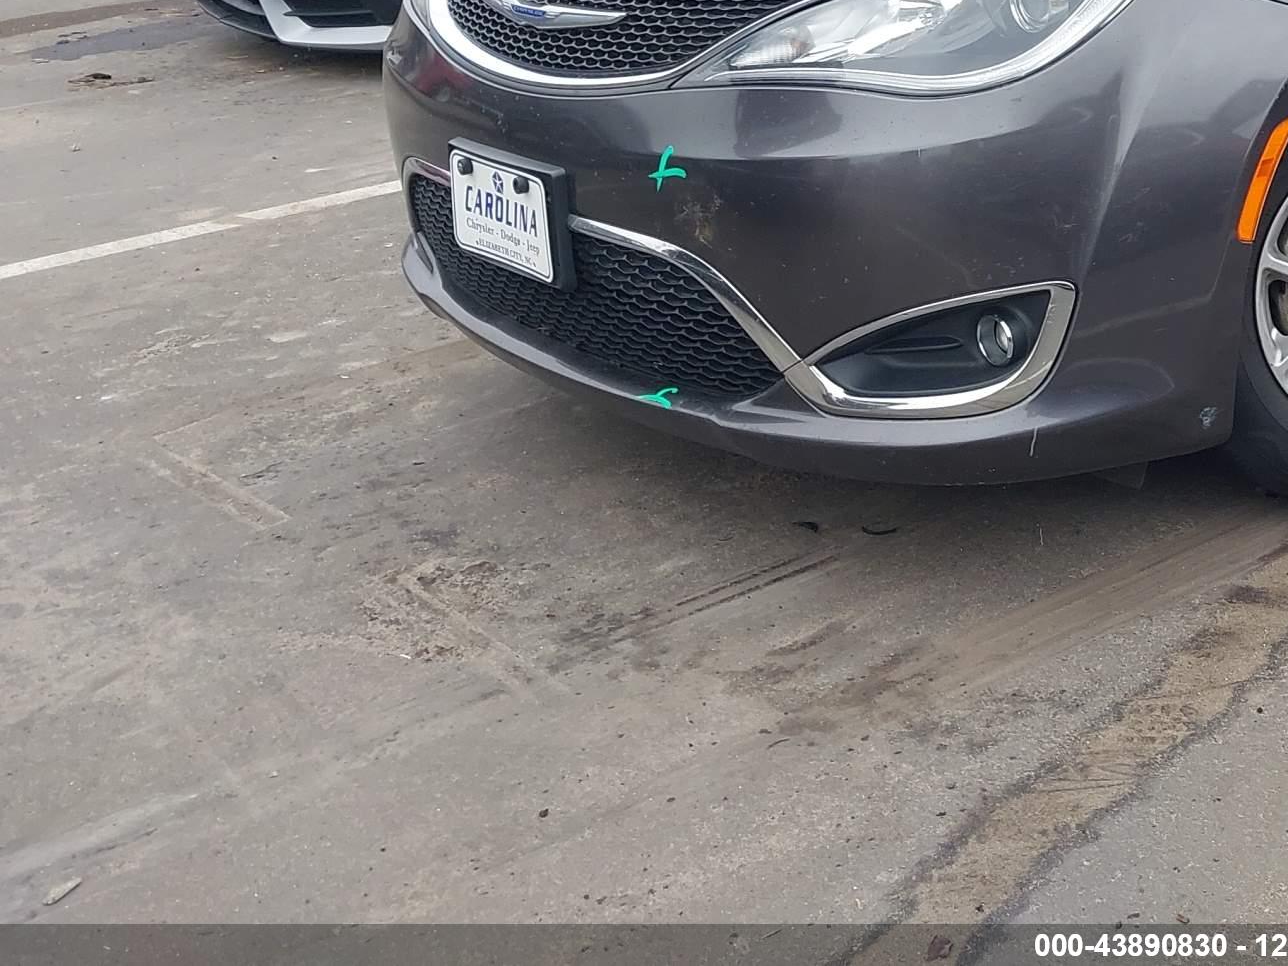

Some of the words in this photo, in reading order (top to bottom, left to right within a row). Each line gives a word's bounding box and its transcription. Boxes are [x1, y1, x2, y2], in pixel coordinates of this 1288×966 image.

[465, 185, 538, 238] CAROLINA
[466, 217, 494, 235] Chrysler
[500, 229, 521, 246] Dodge
[527, 238, 540, 256] Jeep
